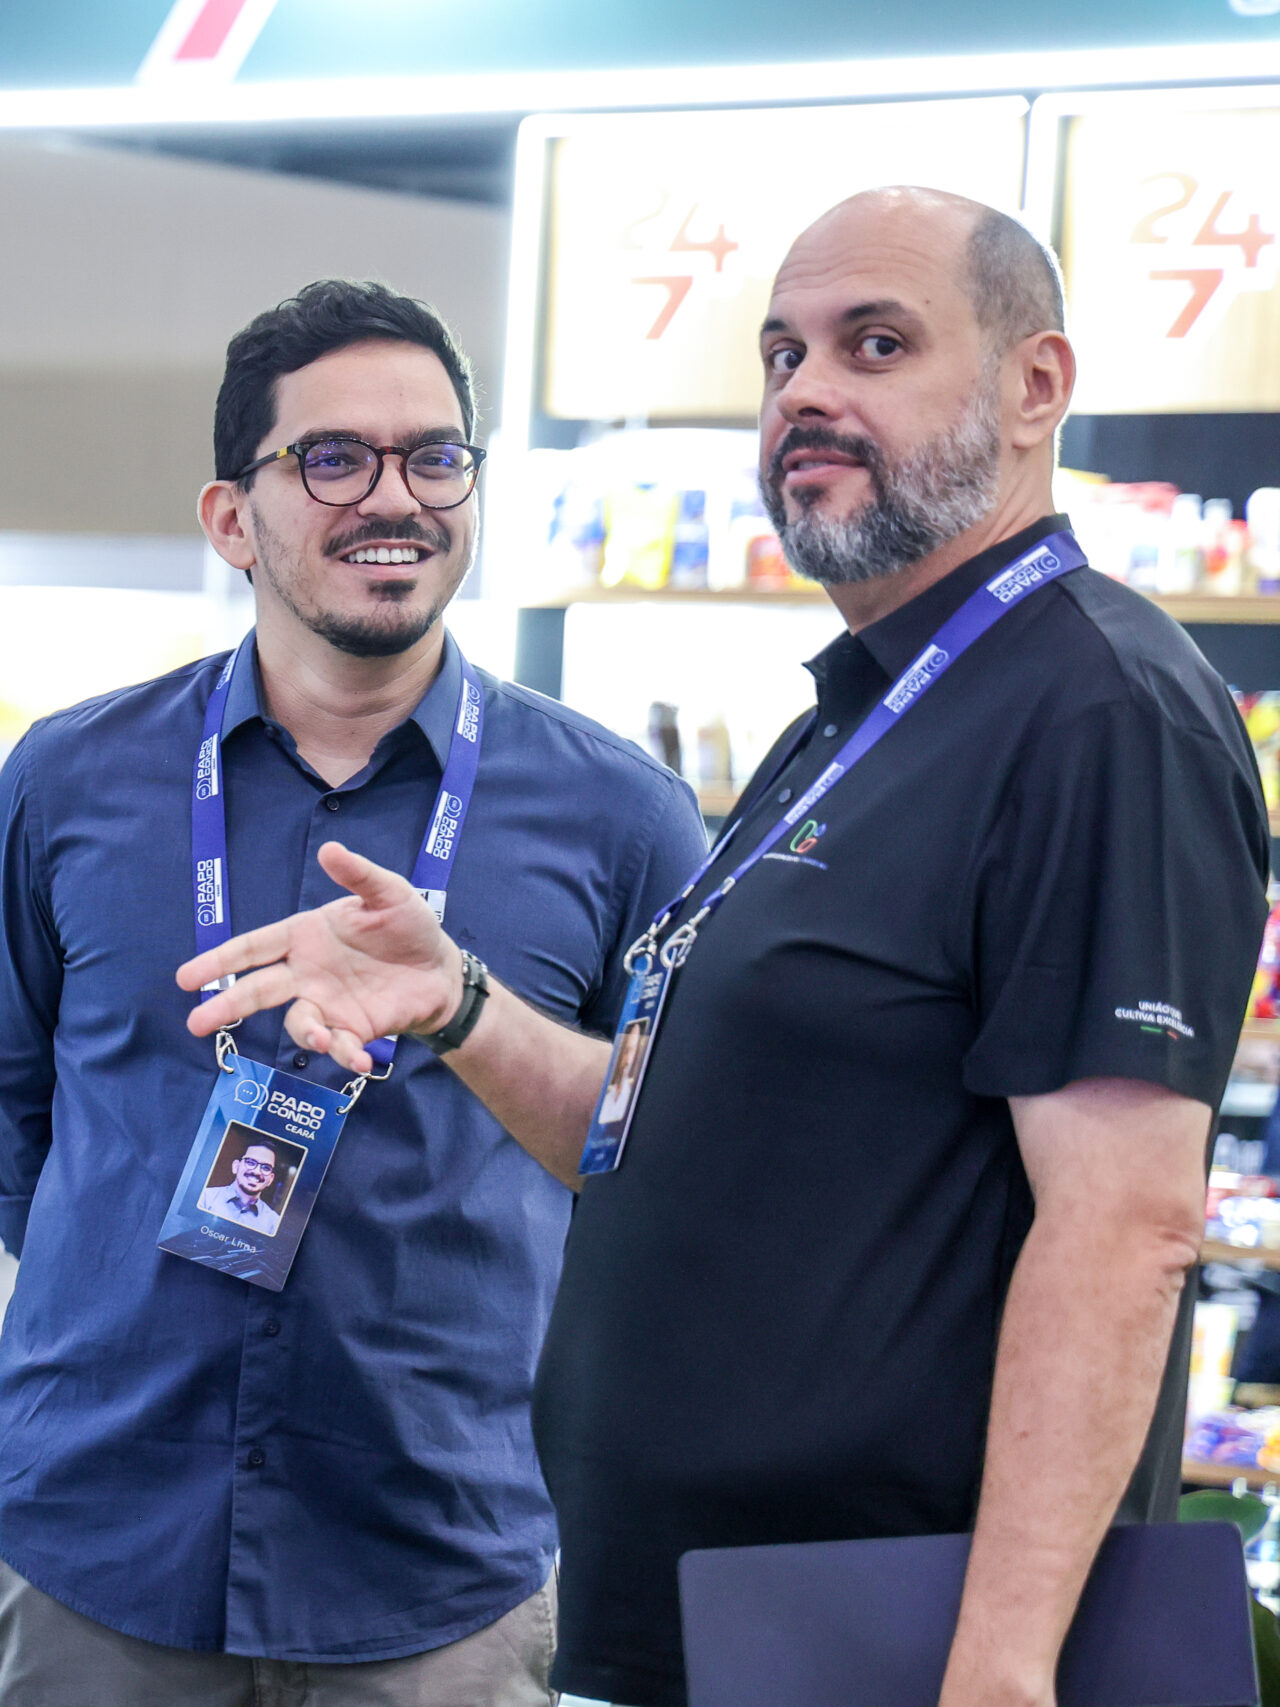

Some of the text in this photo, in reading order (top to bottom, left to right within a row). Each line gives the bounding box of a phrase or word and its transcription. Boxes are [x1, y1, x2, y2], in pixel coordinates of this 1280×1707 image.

[1129, 171, 1276, 268] 24
[630, 275, 693, 340] 7
[1148, 268, 1224, 339] 7
[998, 570, 1043, 603] PAPO
[892, 671, 931, 713] PAPO
[468, 704, 480, 743] PAPO
[197, 739, 208, 779] PAPO
[433, 816, 450, 857] CONDO
[440, 818, 458, 860] PAPO
[197, 860, 207, 903] PAPO
[205, 859, 215, 902] CONDO
[1114, 1007, 1156, 1022] CULTIVA
[1138, 1000, 1170, 1014] UNIÃO
[267, 1102, 322, 1130] CONDO
[270, 1090, 326, 1120] PAPO
[285, 1123, 315, 1140] CEARÁ
[200, 1225, 257, 1254] Oscar Lima
